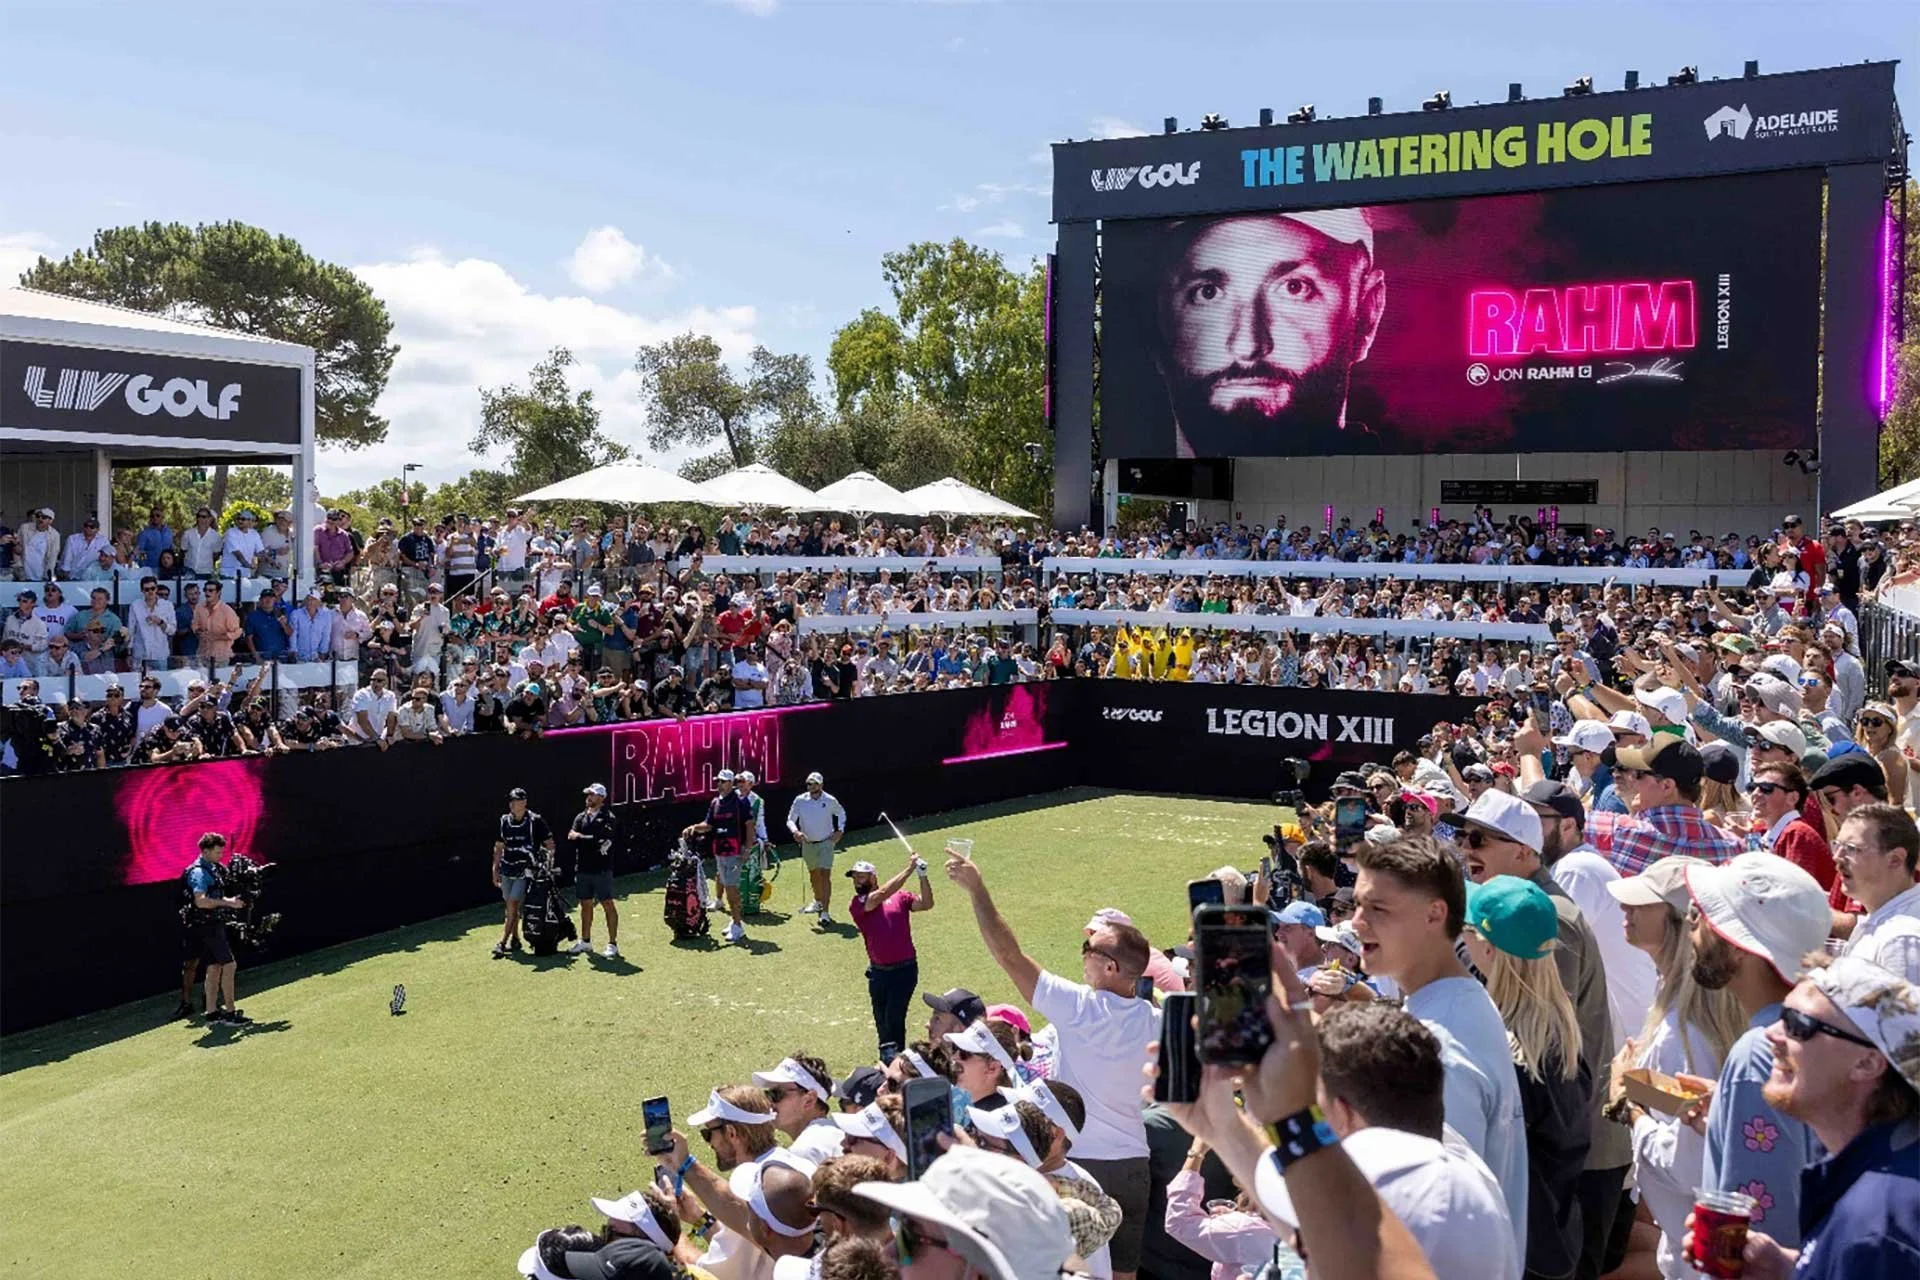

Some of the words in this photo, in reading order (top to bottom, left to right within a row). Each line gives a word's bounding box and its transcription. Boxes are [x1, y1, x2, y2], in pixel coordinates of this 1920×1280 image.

[1754, 109, 1839, 131] ADELAIDE
[1754, 130, 1785, 139] SOUTH
[1788, 124, 1839, 136] AUSTRALIA
[1241, 146, 1304, 187] THE
[1312, 126, 1527, 182] WATERING
[1537, 113, 1653, 165] HOLE
[1090, 166, 1140, 191] LIV
[1139, 160, 1201, 188] GOLF
[1718, 273, 1730, 297] XIII
[1469, 280, 1696, 357] RAHM
[1717, 299, 1730, 350] LEGION
[1493, 368, 1523, 381] JON
[1527, 367, 1575, 380] RAHM
[23, 365, 130, 411] LIV
[125, 374, 242, 420] GOLF
[1129, 708, 1164, 722] GOLF
[1206, 708, 1329, 740] LEGION
[1334, 714, 1394, 745] XIII
[611, 714, 780, 806] RAHM
